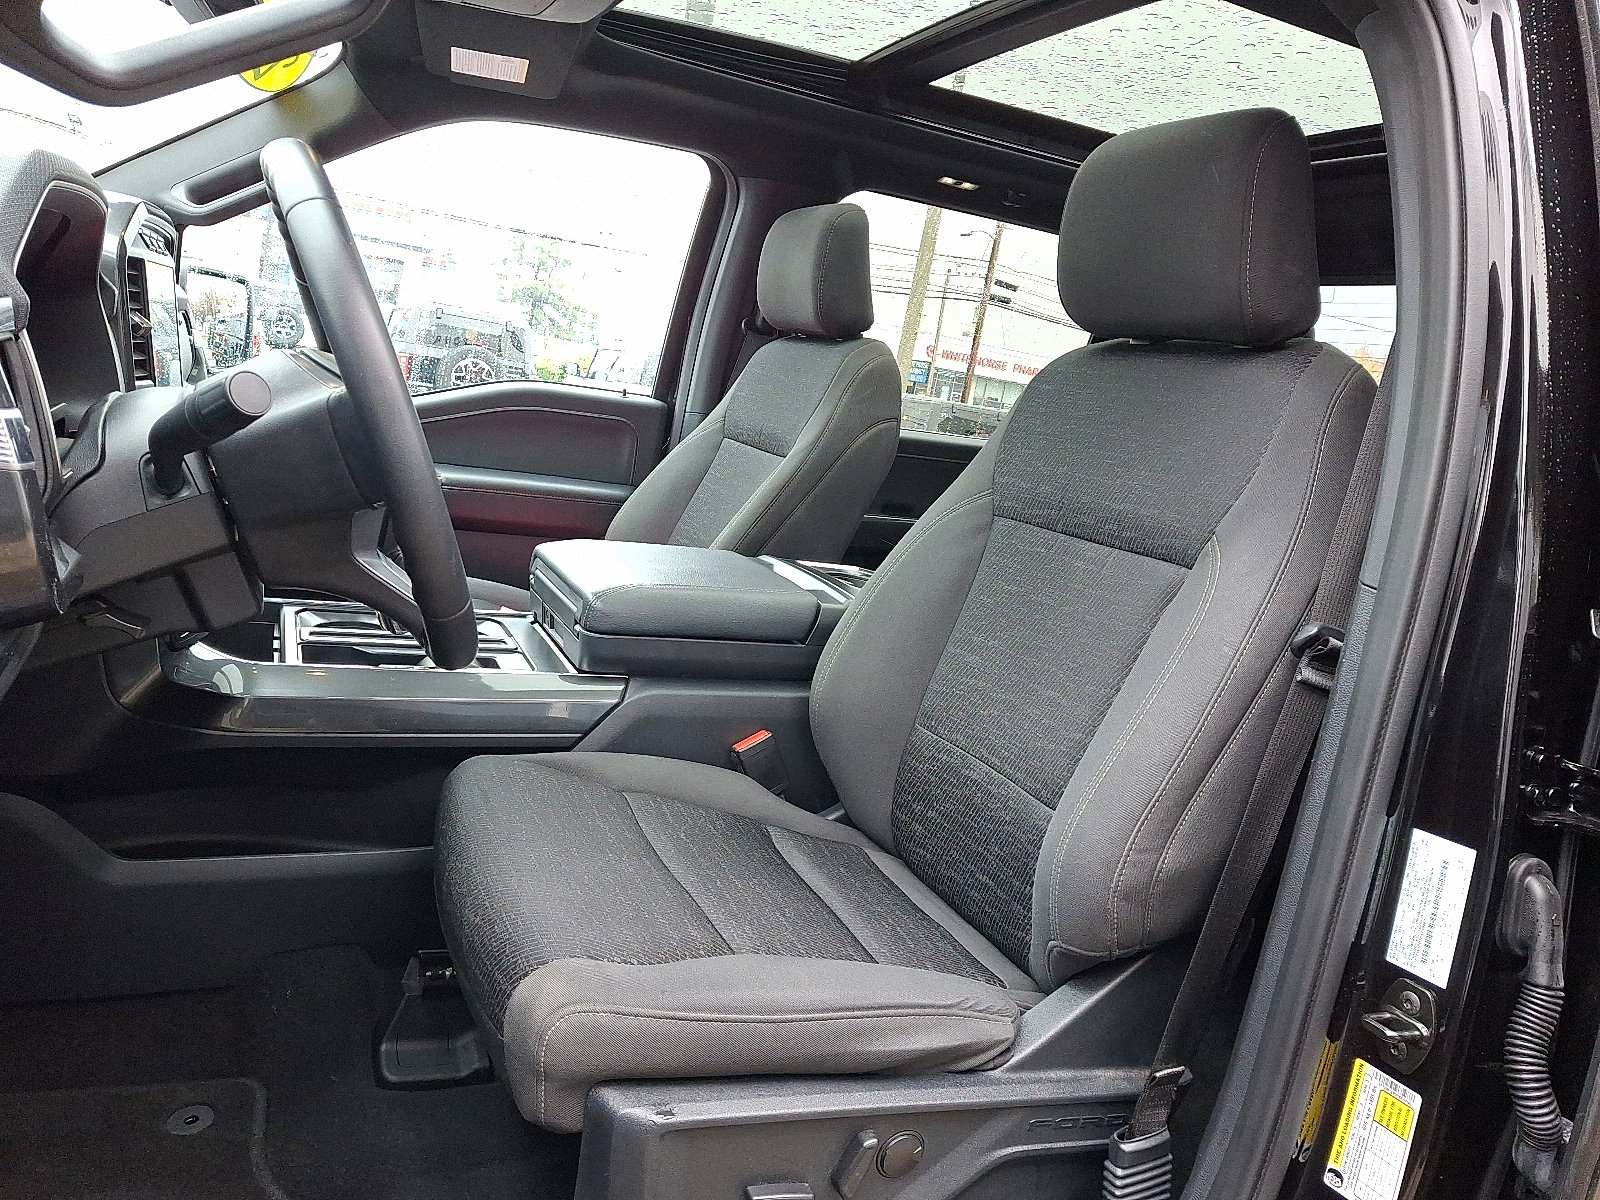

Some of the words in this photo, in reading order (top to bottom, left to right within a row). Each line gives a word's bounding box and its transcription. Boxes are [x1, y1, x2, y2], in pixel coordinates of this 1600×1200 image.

[1349, 1062, 1365, 1107] INFORMATION
[1341, 1107, 1353, 1135] LOADING
[1338, 1135, 1346, 1149] AND
